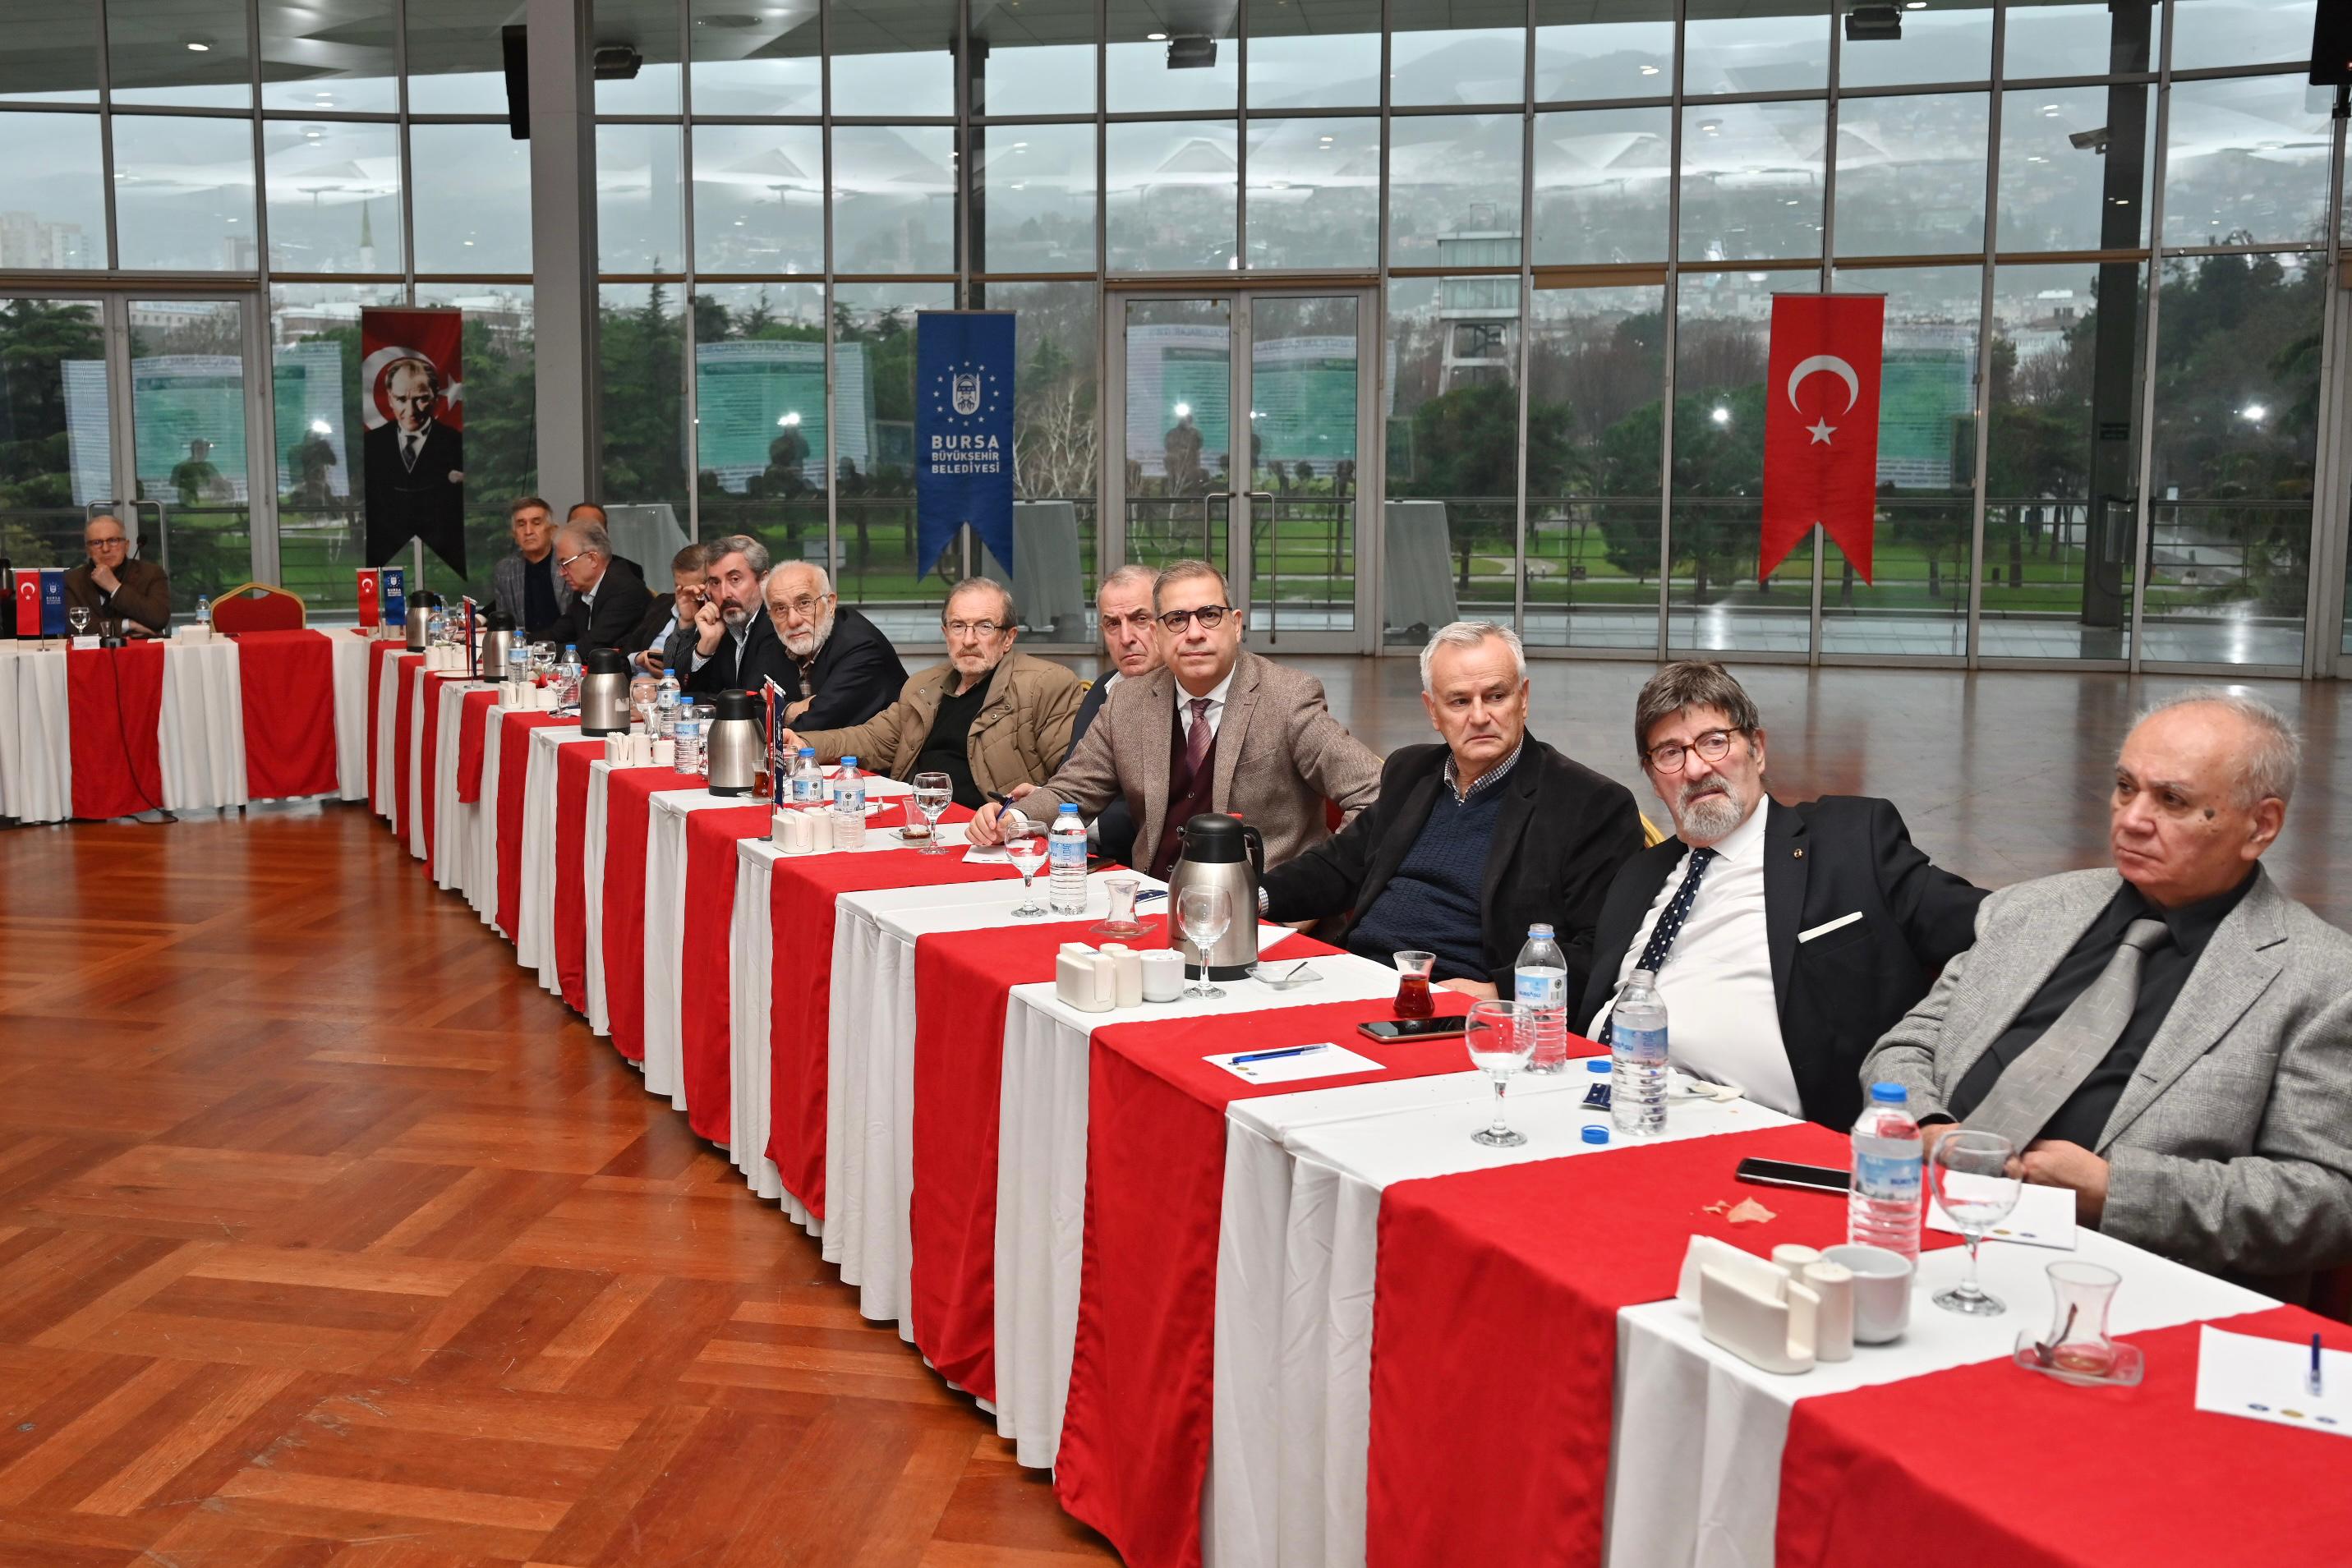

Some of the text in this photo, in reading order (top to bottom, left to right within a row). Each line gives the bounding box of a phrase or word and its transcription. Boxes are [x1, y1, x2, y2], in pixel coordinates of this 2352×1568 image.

[932, 435, 999, 448] BURSA
[932, 449, 999, 462] BÜYÜKŞEHİR
[932, 462, 1000, 474] BELEDİYESİ
